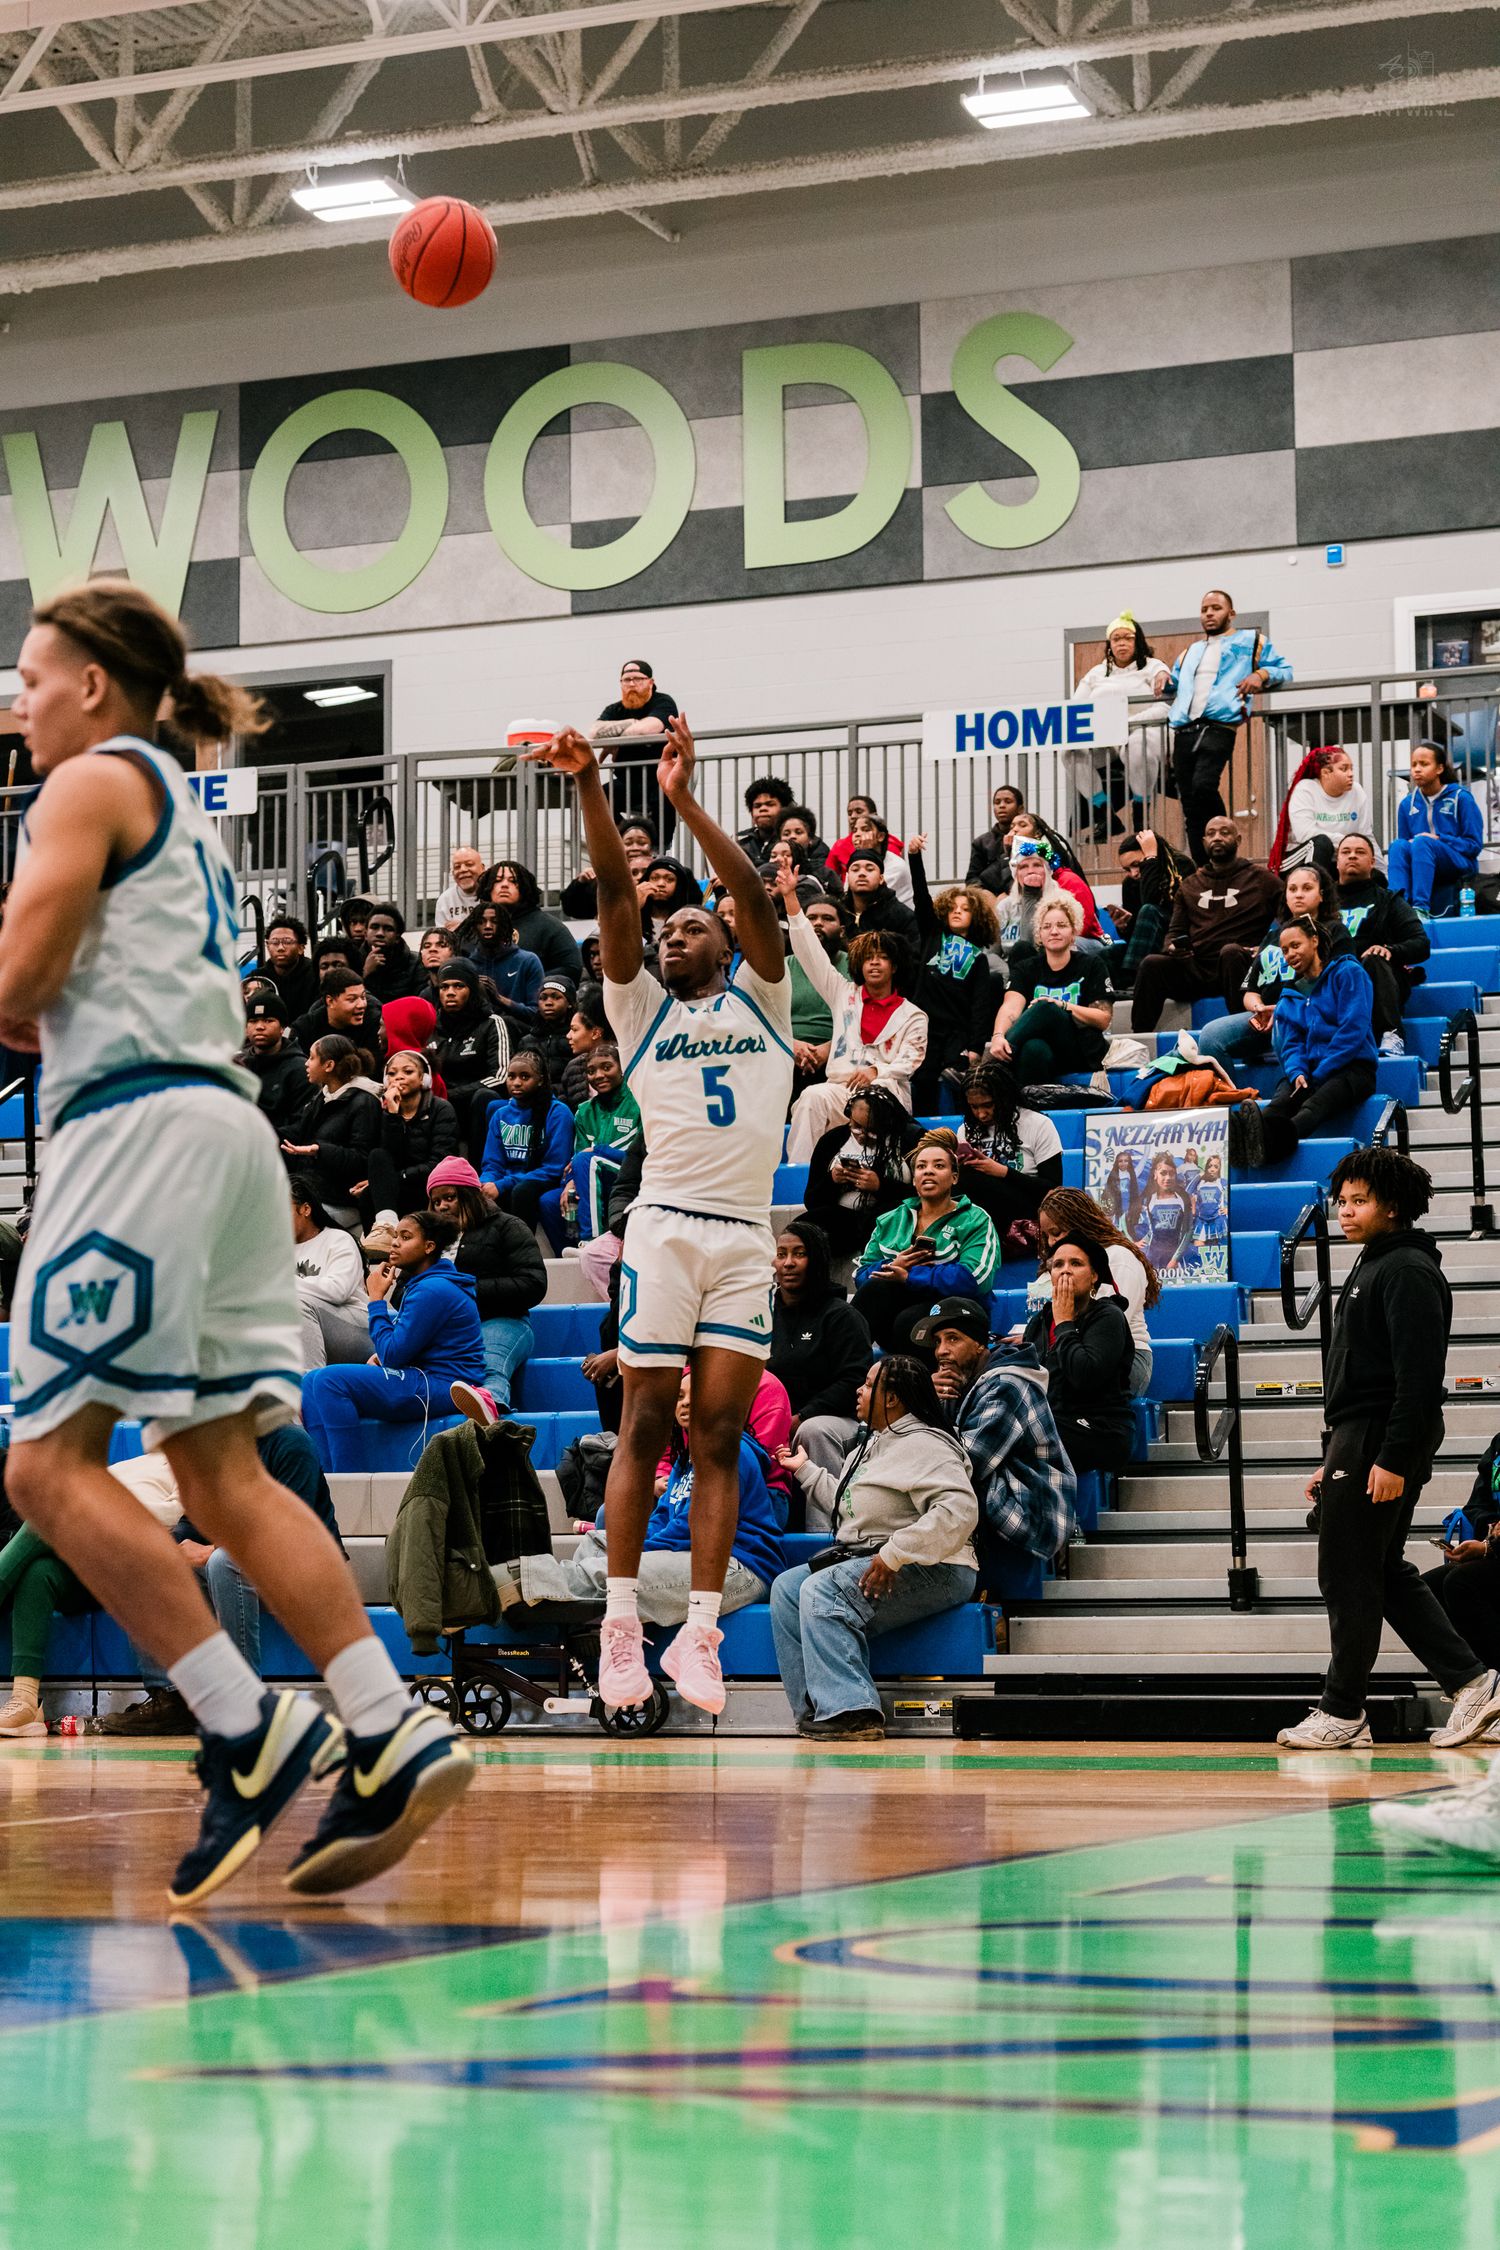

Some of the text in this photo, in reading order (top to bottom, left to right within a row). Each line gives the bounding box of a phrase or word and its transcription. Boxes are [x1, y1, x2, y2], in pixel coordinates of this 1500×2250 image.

[3, 311, 1081, 620] WOODS
[955, 702, 1095, 753] HOME
[187, 774, 228, 811] E
[655, 1033, 767, 1062] Warriors
[701, 1064, 737, 1128] 5
[1104, 1119, 1228, 1148] NEZZARYAH
[1198, 1245, 1228, 1275] W
[66, 1278, 120, 1326] W
[497, 1648, 530, 1656] BlessReach
